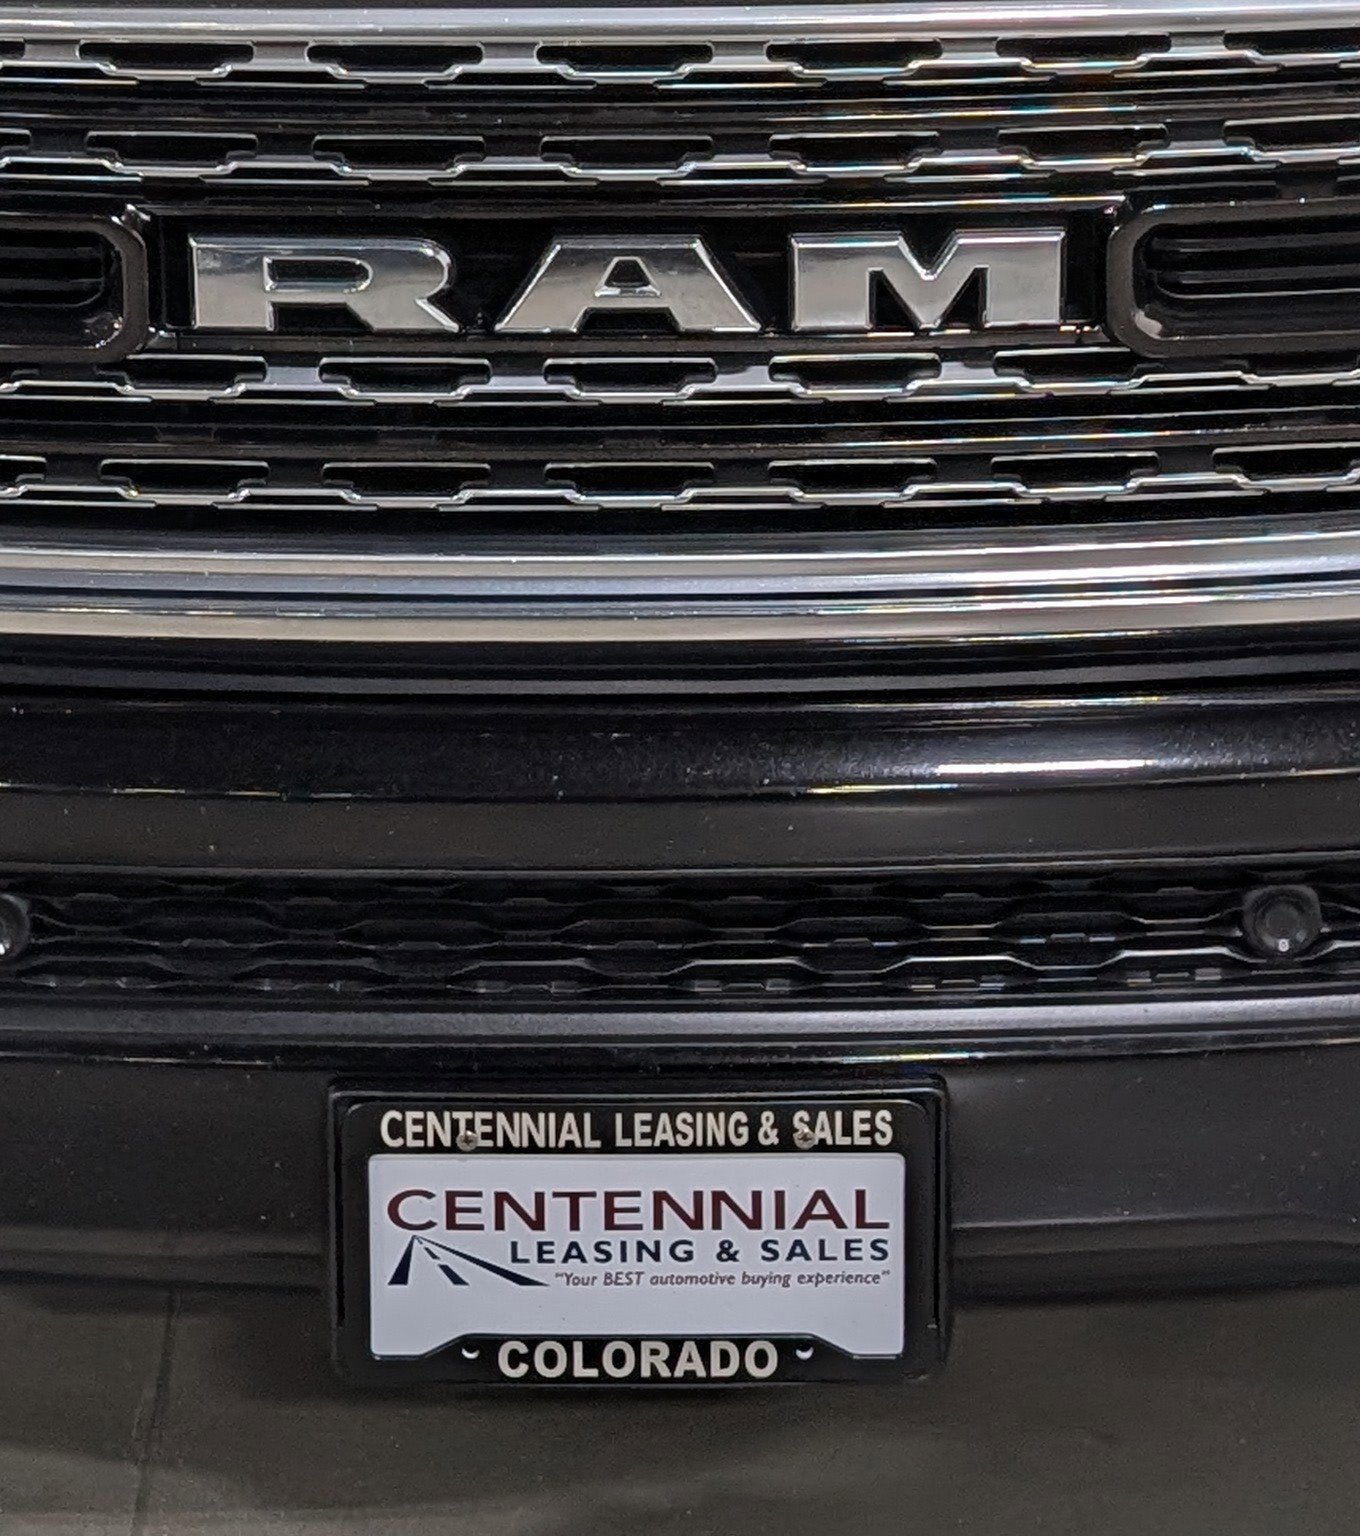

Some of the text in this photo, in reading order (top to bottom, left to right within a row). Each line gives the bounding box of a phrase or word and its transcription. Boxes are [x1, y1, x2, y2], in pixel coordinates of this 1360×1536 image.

[188, 232, 1066, 333] RAM
[380, 1109, 602, 1149] CENTENNIAL
[615, 1111, 749, 1148] LEASING
[757, 1111, 780, 1146] &
[387, 1188, 891, 1232] CENTENNIAL
[510, 1237, 890, 1265] LEASING & SALES
[602, 1270, 646, 1287] BEST
[649, 1271, 736, 1286] automotive
[740, 1270, 792, 1289] buying
[498, 1340, 779, 1378] COLORADO
